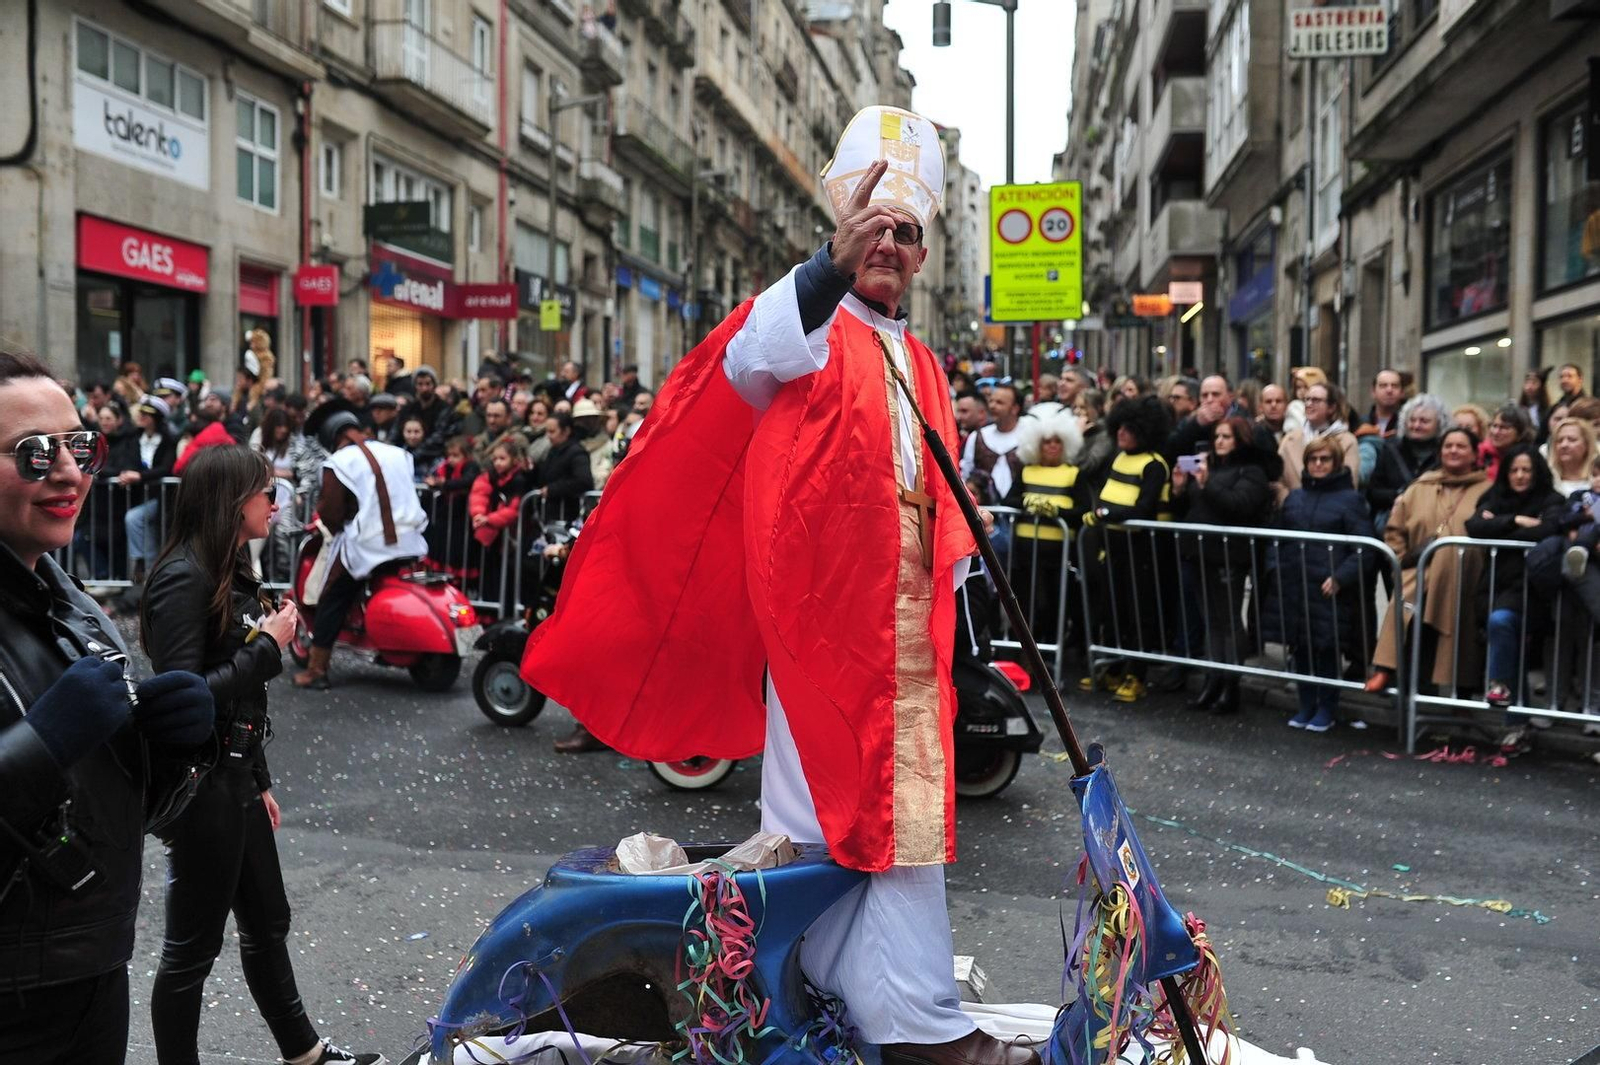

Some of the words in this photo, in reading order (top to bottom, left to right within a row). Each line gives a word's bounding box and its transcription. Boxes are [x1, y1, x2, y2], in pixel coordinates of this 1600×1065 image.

[1294, 10, 1385, 28] SASTRERIA
[1308, 30, 1385, 51] IGLESIAS
[104, 99, 182, 159] talento
[1045, 217, 1068, 231] 20
[122, 236, 175, 276] GAES
[300, 277, 332, 291] GAES
[394, 279, 444, 311] arenal
[465, 294, 511, 308] arenal
